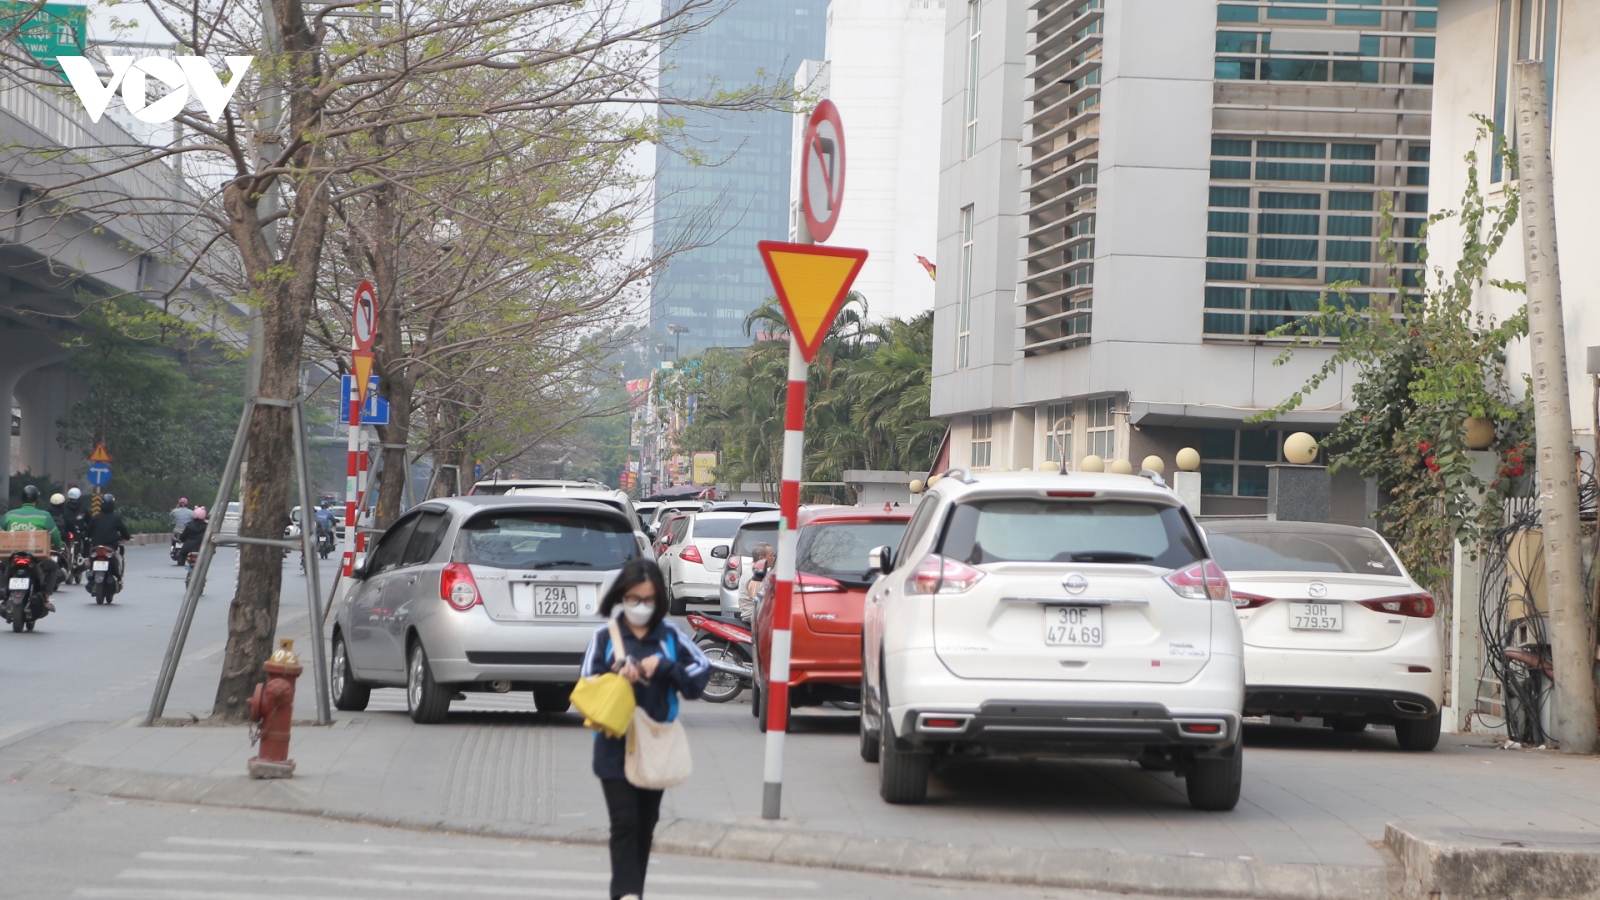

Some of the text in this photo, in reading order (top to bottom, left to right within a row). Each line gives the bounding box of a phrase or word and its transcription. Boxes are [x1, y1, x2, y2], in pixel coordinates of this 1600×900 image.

[11, 522, 36, 532] Grab
[544, 587, 567, 601] 29A
[537, 601, 577, 615] 122.90
[1304, 604, 1328, 616] 30H
[1059, 607, 1089, 625] 30F
[1295, 616, 1337, 629] 779.57
[1047, 626, 1101, 644] 474.69
